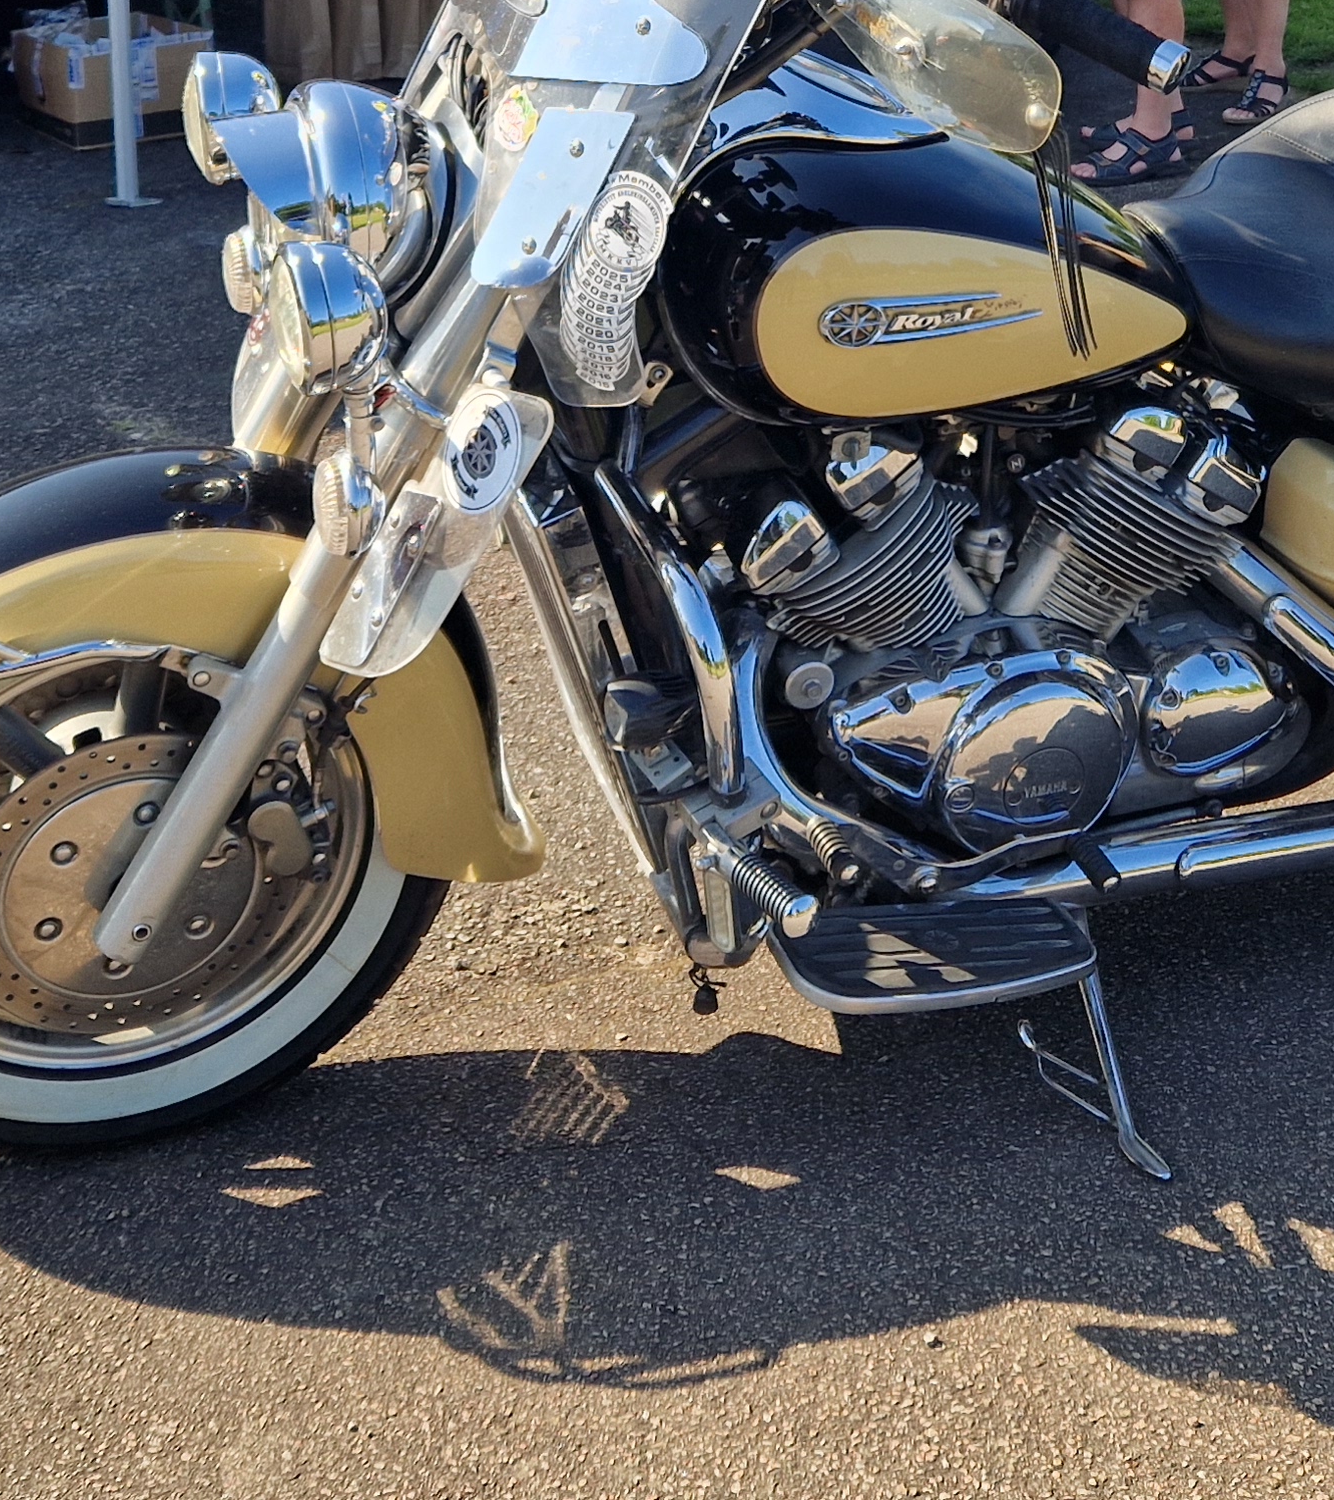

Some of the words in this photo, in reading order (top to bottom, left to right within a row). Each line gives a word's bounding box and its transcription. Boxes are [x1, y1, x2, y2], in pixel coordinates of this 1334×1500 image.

[618, 173, 667, 206] Member
[586, 267, 622, 292] 2024
[591, 259, 628, 283] 2025
[582, 279, 619, 303] 2023
[578, 293, 615, 315] 2022
[576, 307, 612, 326] 2021
[889, 306, 975, 331] Royal
[575, 321, 614, 339] 2020
[1024, 781, 1068, 798] YAMAHA
